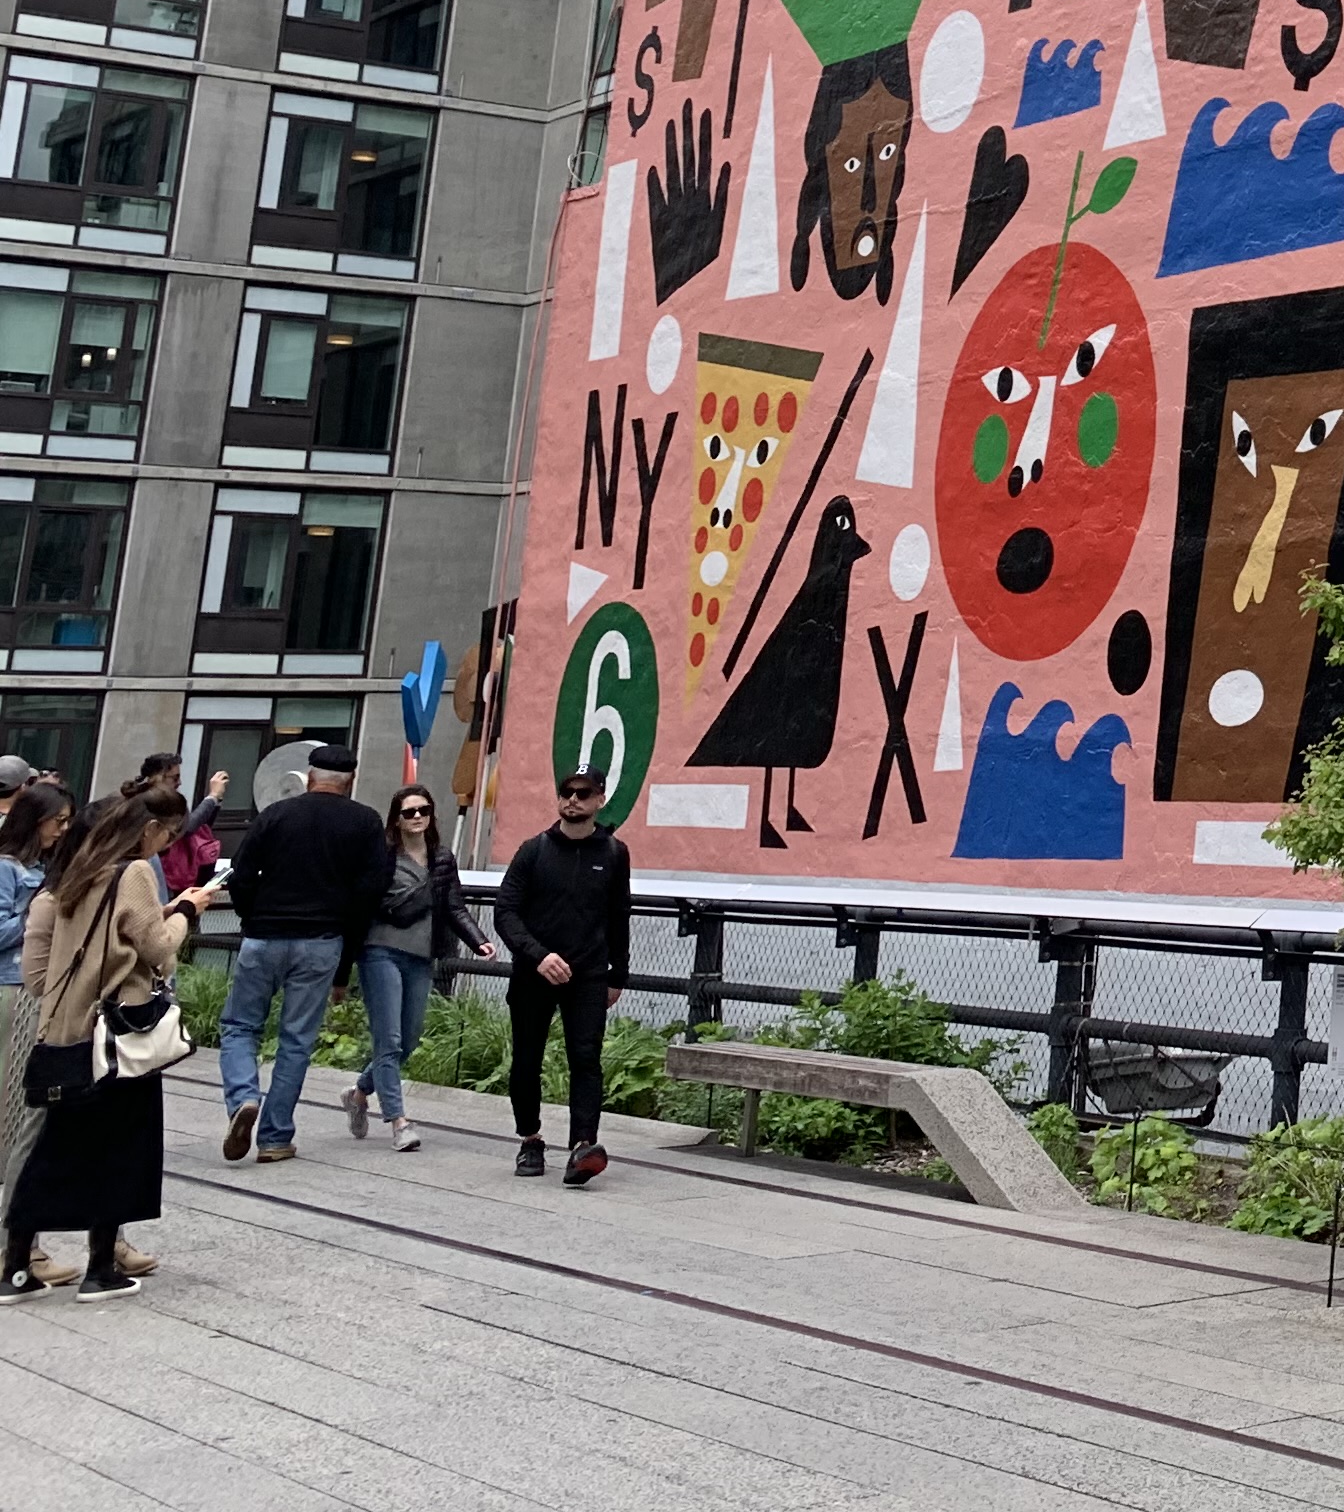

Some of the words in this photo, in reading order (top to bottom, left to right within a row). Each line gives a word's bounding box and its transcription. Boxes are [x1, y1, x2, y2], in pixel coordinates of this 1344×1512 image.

[628, 26, 662, 137] $
[575, 383, 678, 590] NY
[579, 629, 631, 808] 6
[862, 610, 928, 841] X
